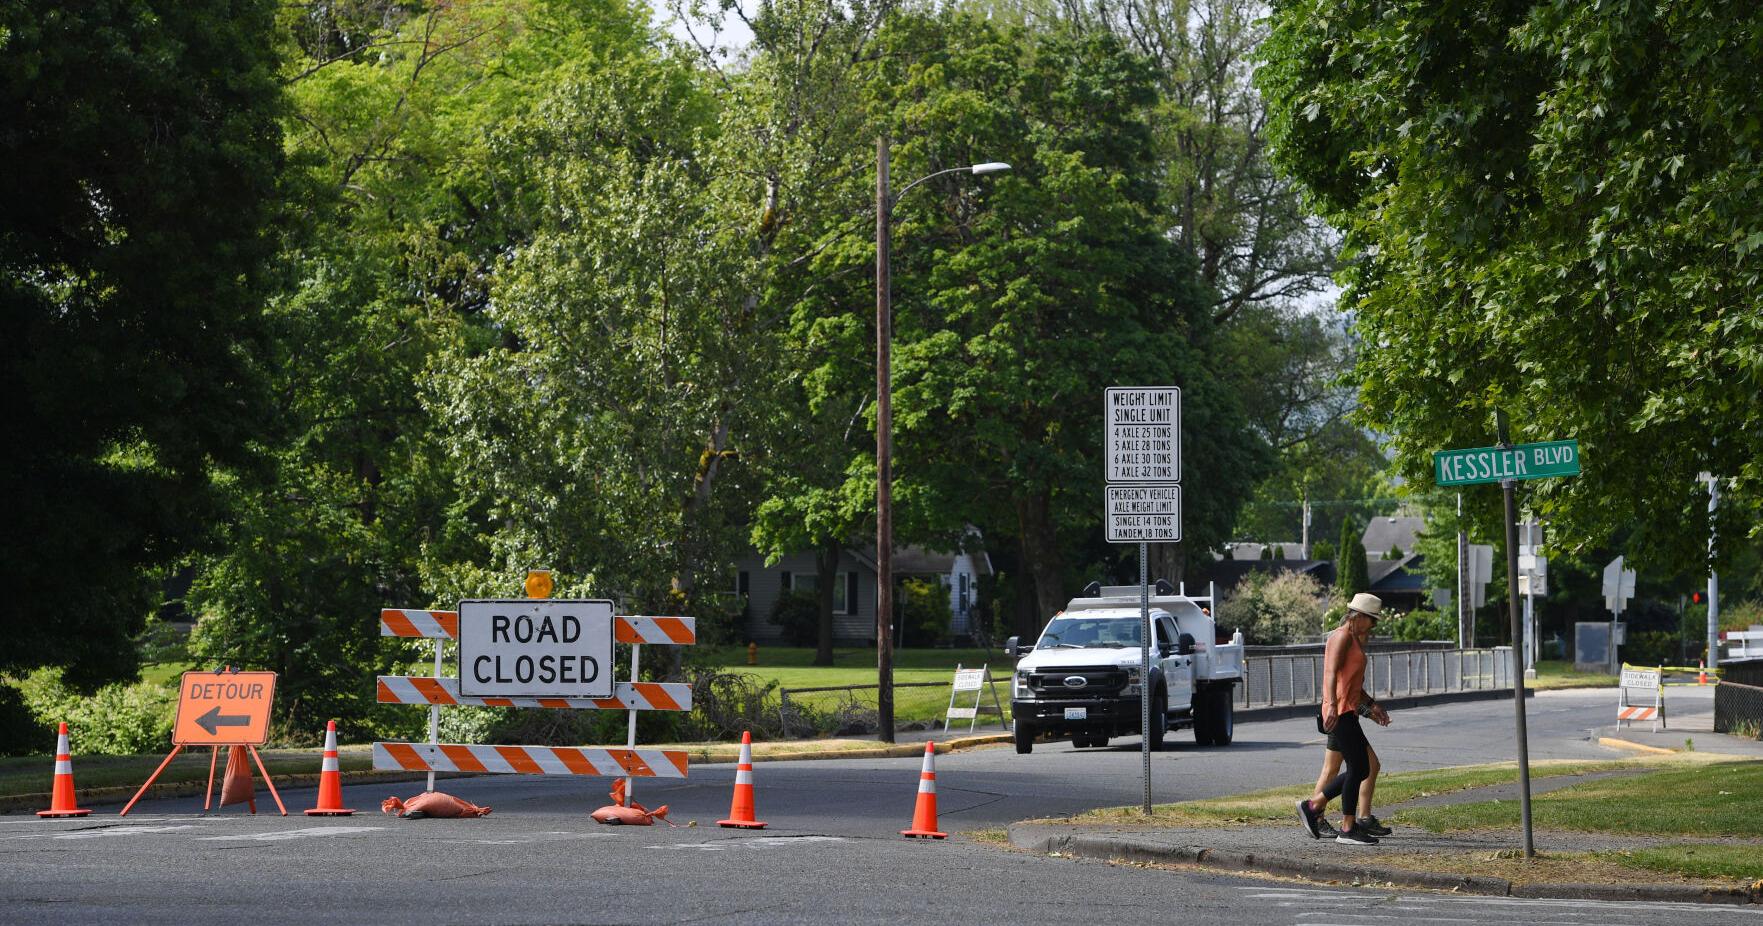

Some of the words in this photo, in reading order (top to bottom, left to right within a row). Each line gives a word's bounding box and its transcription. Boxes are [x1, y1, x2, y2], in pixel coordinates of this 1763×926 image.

[1113, 392, 1146, 406] WEIGHT
[1149, 392, 1172, 406] LIMIT
[1114, 408, 1146, 422] SINGLE
[1150, 408, 1171, 422] UNIT
[1114, 427, 1119, 438] 4
[1121, 427, 1140, 438] AXLE
[1141, 427, 1150, 438] 25
[1152, 427, 1171, 438] TONS
[1115, 440, 1119, 451] 5
[1121, 440, 1140, 451] AXLE
[1141, 440, 1150, 451] 28
[1152, 440, 1171, 451] TONS
[1114, 453, 1119, 464] 6
[1121, 453, 1140, 464] AXLE
[1141, 453, 1150, 464] 30
[1152, 453, 1171, 464] TONS
[1440, 450, 1527, 482] KESSLER
[1534, 445, 1573, 466] BLVD
[1114, 466, 1119, 477] 7
[1121, 466, 1140, 477] AXLE
[1141, 466, 1151, 477] 32
[1153, 466, 1171, 477] TONS
[1111, 489, 1147, 500] EMERGENCY
[1150, 489, 1175, 500] VEHICLE
[1114, 501, 1129, 513] AXLE
[1131, 501, 1153, 513] WEIGHT
[1156, 501, 1172, 513] LIMIT
[1115, 516, 1141, 527] SINGLE
[1143, 516, 1151, 527] 14
[1153, 516, 1171, 527] TONS
[1114, 528, 1143, 539] TANDEM
[1144, 528, 1153, 539] 18
[1154, 528, 1173, 539] TONS
[492, 615, 581, 643] ROAD
[473, 655, 599, 684] CLOSED
[1624, 672, 1656, 680] SIDEWALK
[190, 683, 264, 699] DETOUR
